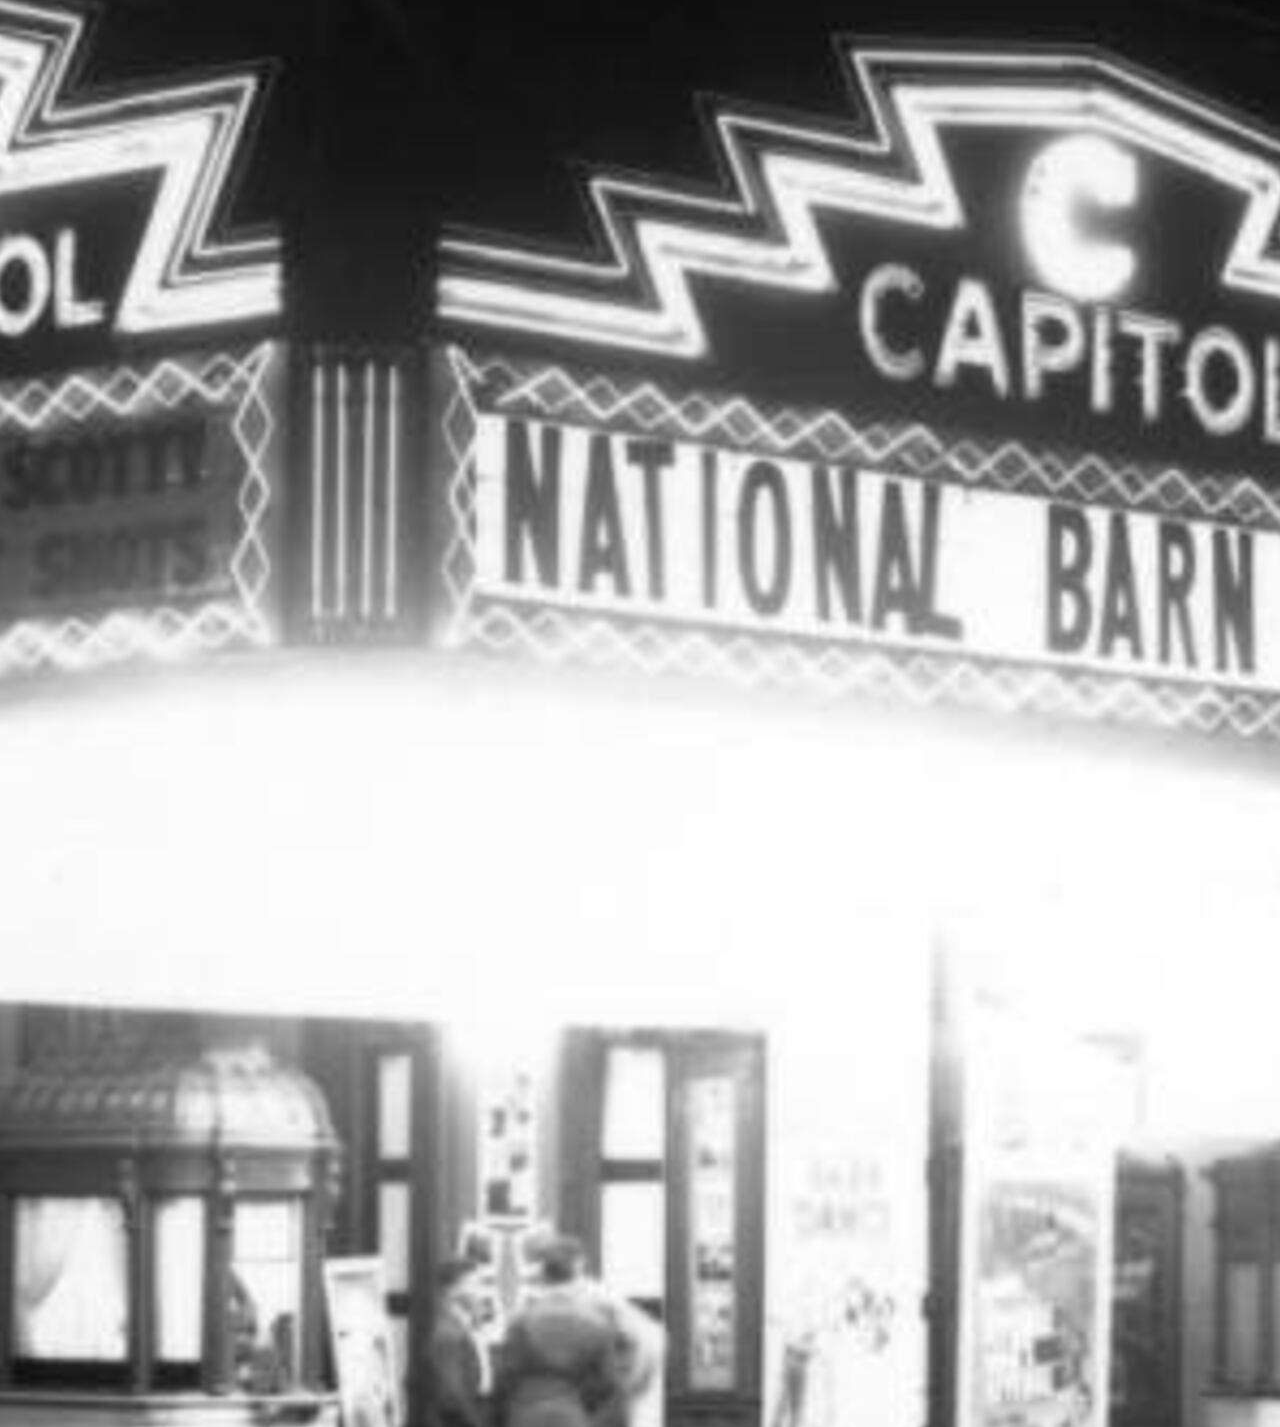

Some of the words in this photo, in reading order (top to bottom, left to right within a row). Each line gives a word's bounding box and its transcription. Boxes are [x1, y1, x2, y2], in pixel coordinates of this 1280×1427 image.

[1020, 132, 1136, 302] C
[502, 419, 963, 641] NATIONAL
[1045, 502, 1256, 674] BARN
